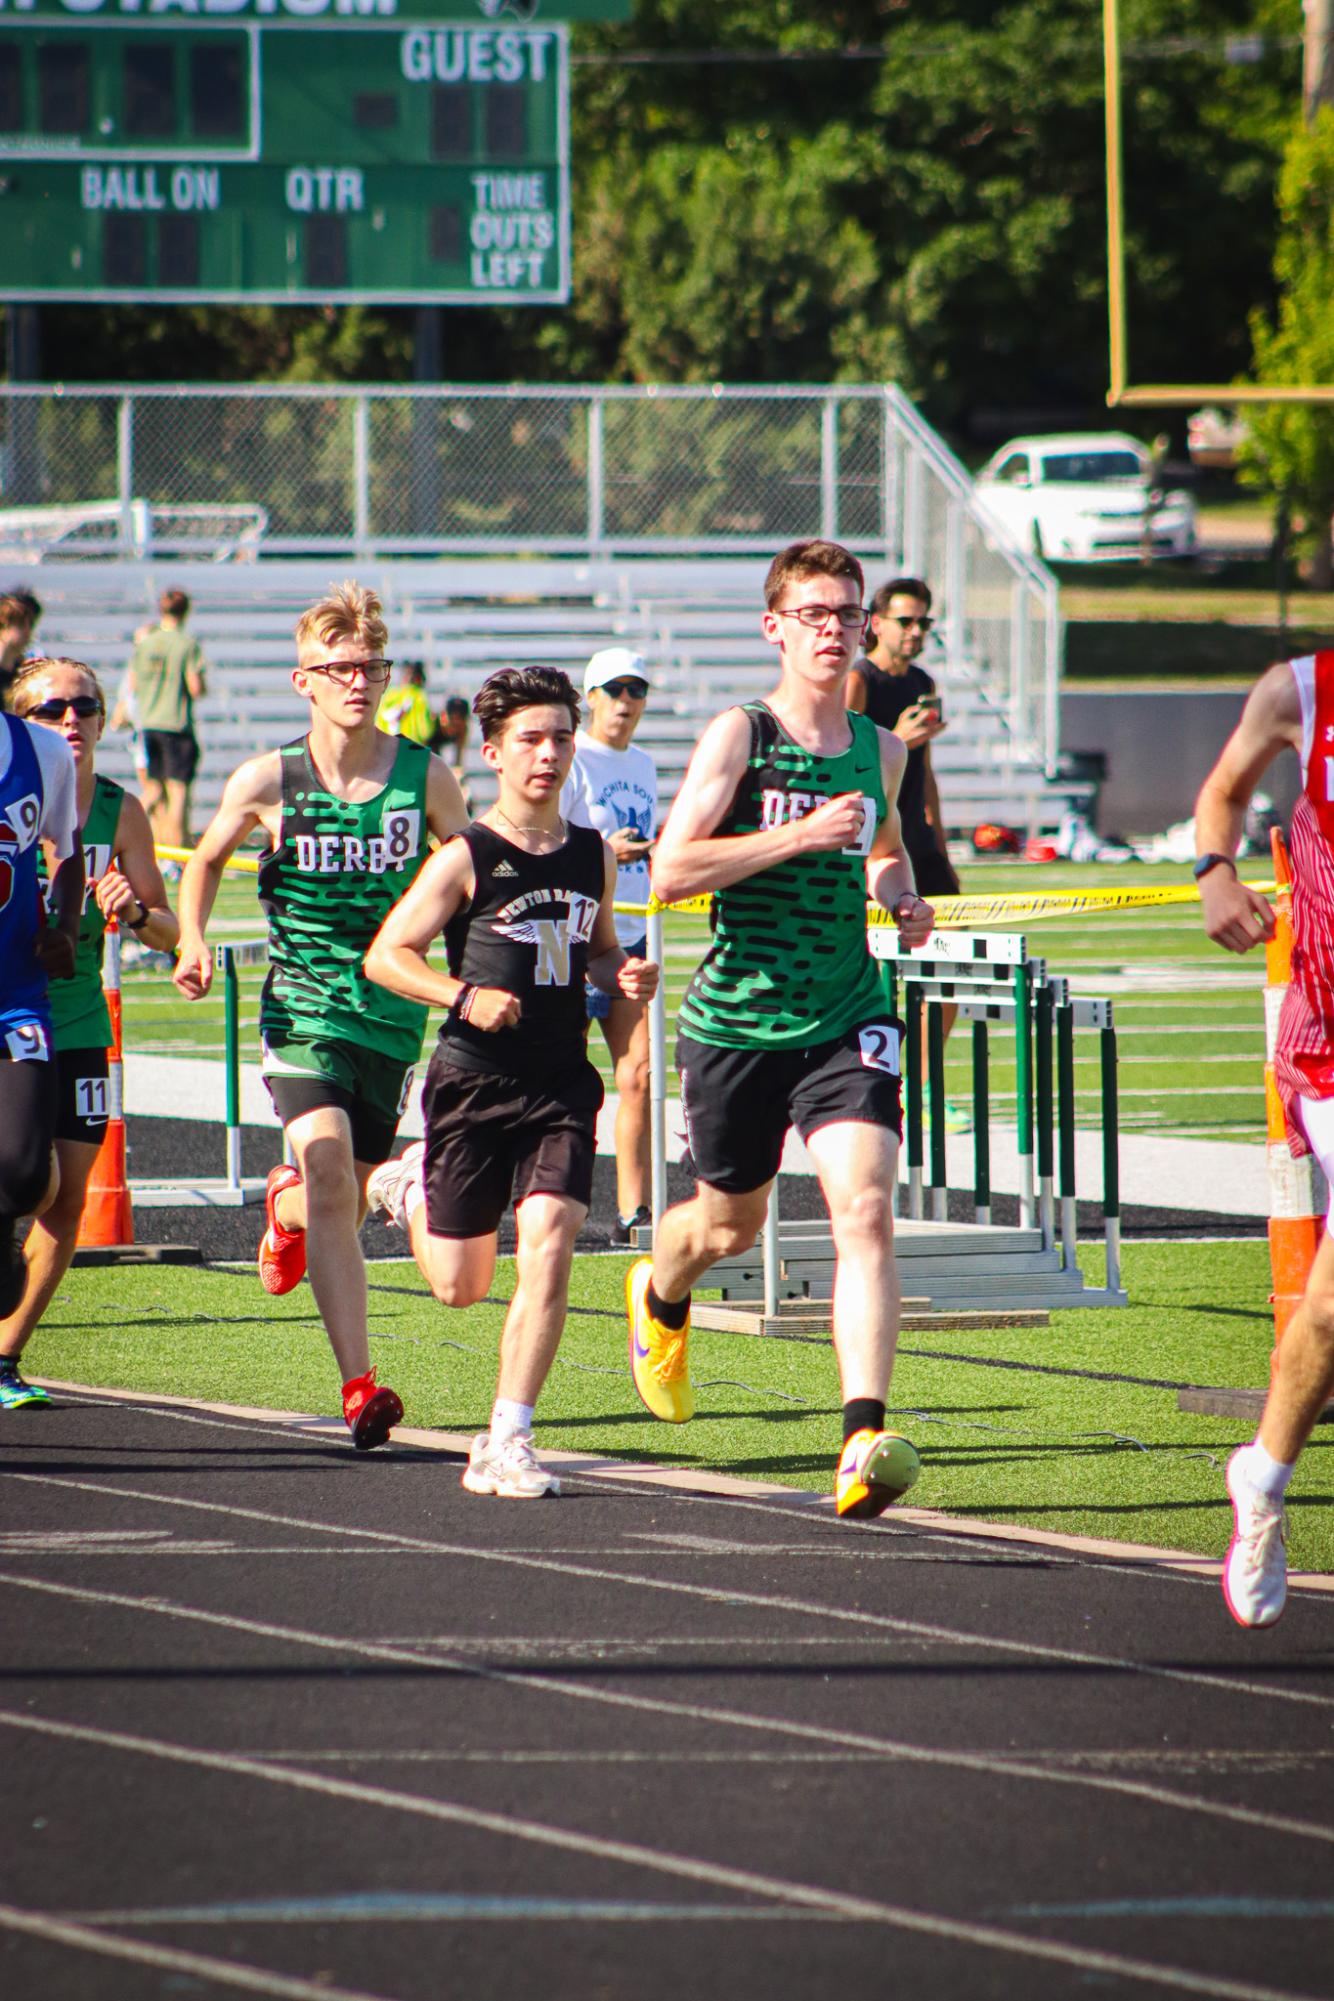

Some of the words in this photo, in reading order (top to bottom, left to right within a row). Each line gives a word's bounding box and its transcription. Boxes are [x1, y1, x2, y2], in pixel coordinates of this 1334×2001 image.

[402, 31, 549, 82] GUEST
[82, 167, 165, 209] BALL
[171, 167, 219, 210] ON
[285, 167, 363, 211] QTR
[471, 172, 544, 210] TIME
[470, 212, 554, 251] OUTS
[471, 252, 544, 287] LEFT
[596, 780, 631, 808] WICHITA
[20, 801, 38, 842] 9
[389, 816, 410, 858] 8
[491, 870, 519, 878] adidas
[496, 888, 553, 924] NEWTON
[574, 899, 596, 937] 12
[534, 919, 571, 987] N
[864, 1029, 891, 1069] 2
[80, 1080, 106, 1113] 11
